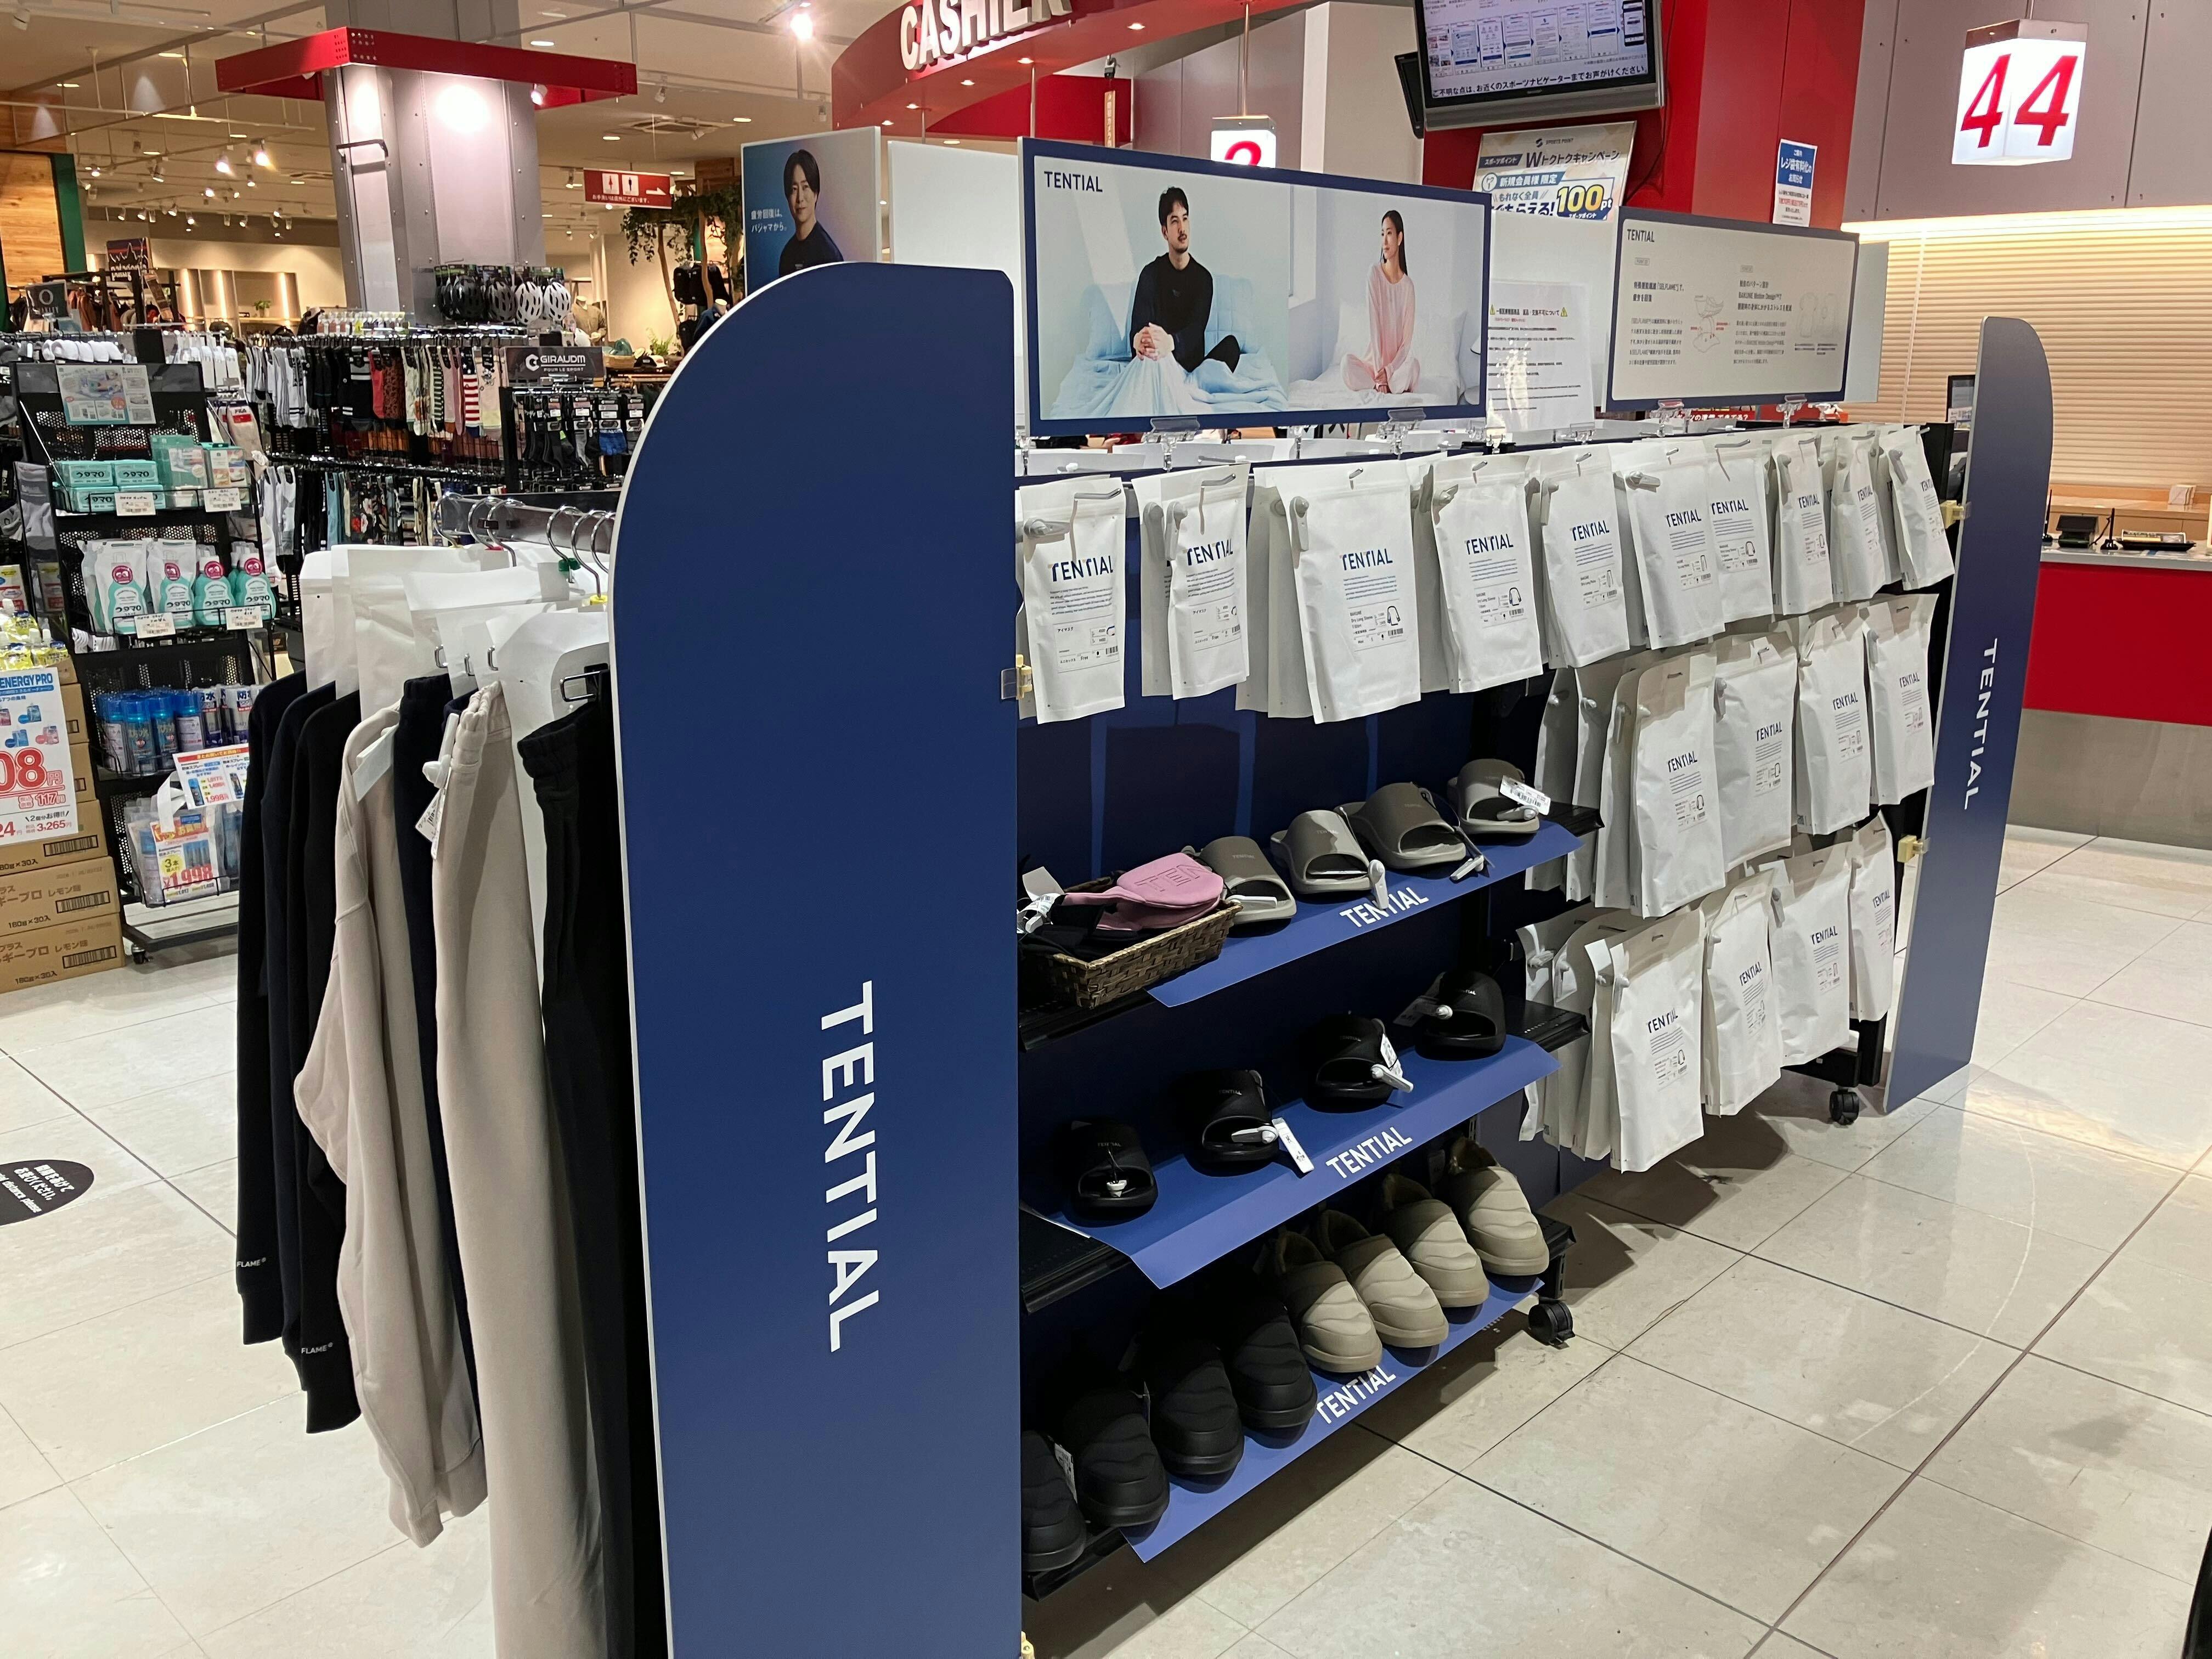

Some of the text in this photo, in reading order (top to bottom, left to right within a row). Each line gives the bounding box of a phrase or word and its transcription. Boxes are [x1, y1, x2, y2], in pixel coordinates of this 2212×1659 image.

[1044, 171, 1103, 192] TENTIAL
[1627, 229, 1655, 242] TENTIAL
[1711, 499, 1749, 515] TENTIAL
[1665, 509, 1702, 528] TENTIAL
[1571, 520, 1610, 541] TENTIAL
[1183, 538, 1234, 566] TENTIAL
[1464, 533, 1514, 555] TENTIAL
[1048, 555, 1114, 582] TENTIAL
[1339, 548, 1393, 571] TENTIAL
[1899, 672, 1920, 689] TENTIAL
[1832, 692, 1859, 711] TENTIAL
[1756, 721, 1782, 742] TENTIAL
[1963, 637, 1998, 810] TENTIAL
[1667, 751, 1698, 773] TENTIAL
[1810, 926, 1838, 945] TENTIAL
[1739, 961, 1763, 986] TENTIAL
[1645, 1007, 1679, 1034] TENTIAL
[1325, 1126, 1413, 1180] TENTIAL
[821, 980, 880, 1353] TENTIAL
[1316, 1365, 1397, 1424] TENTIAL
